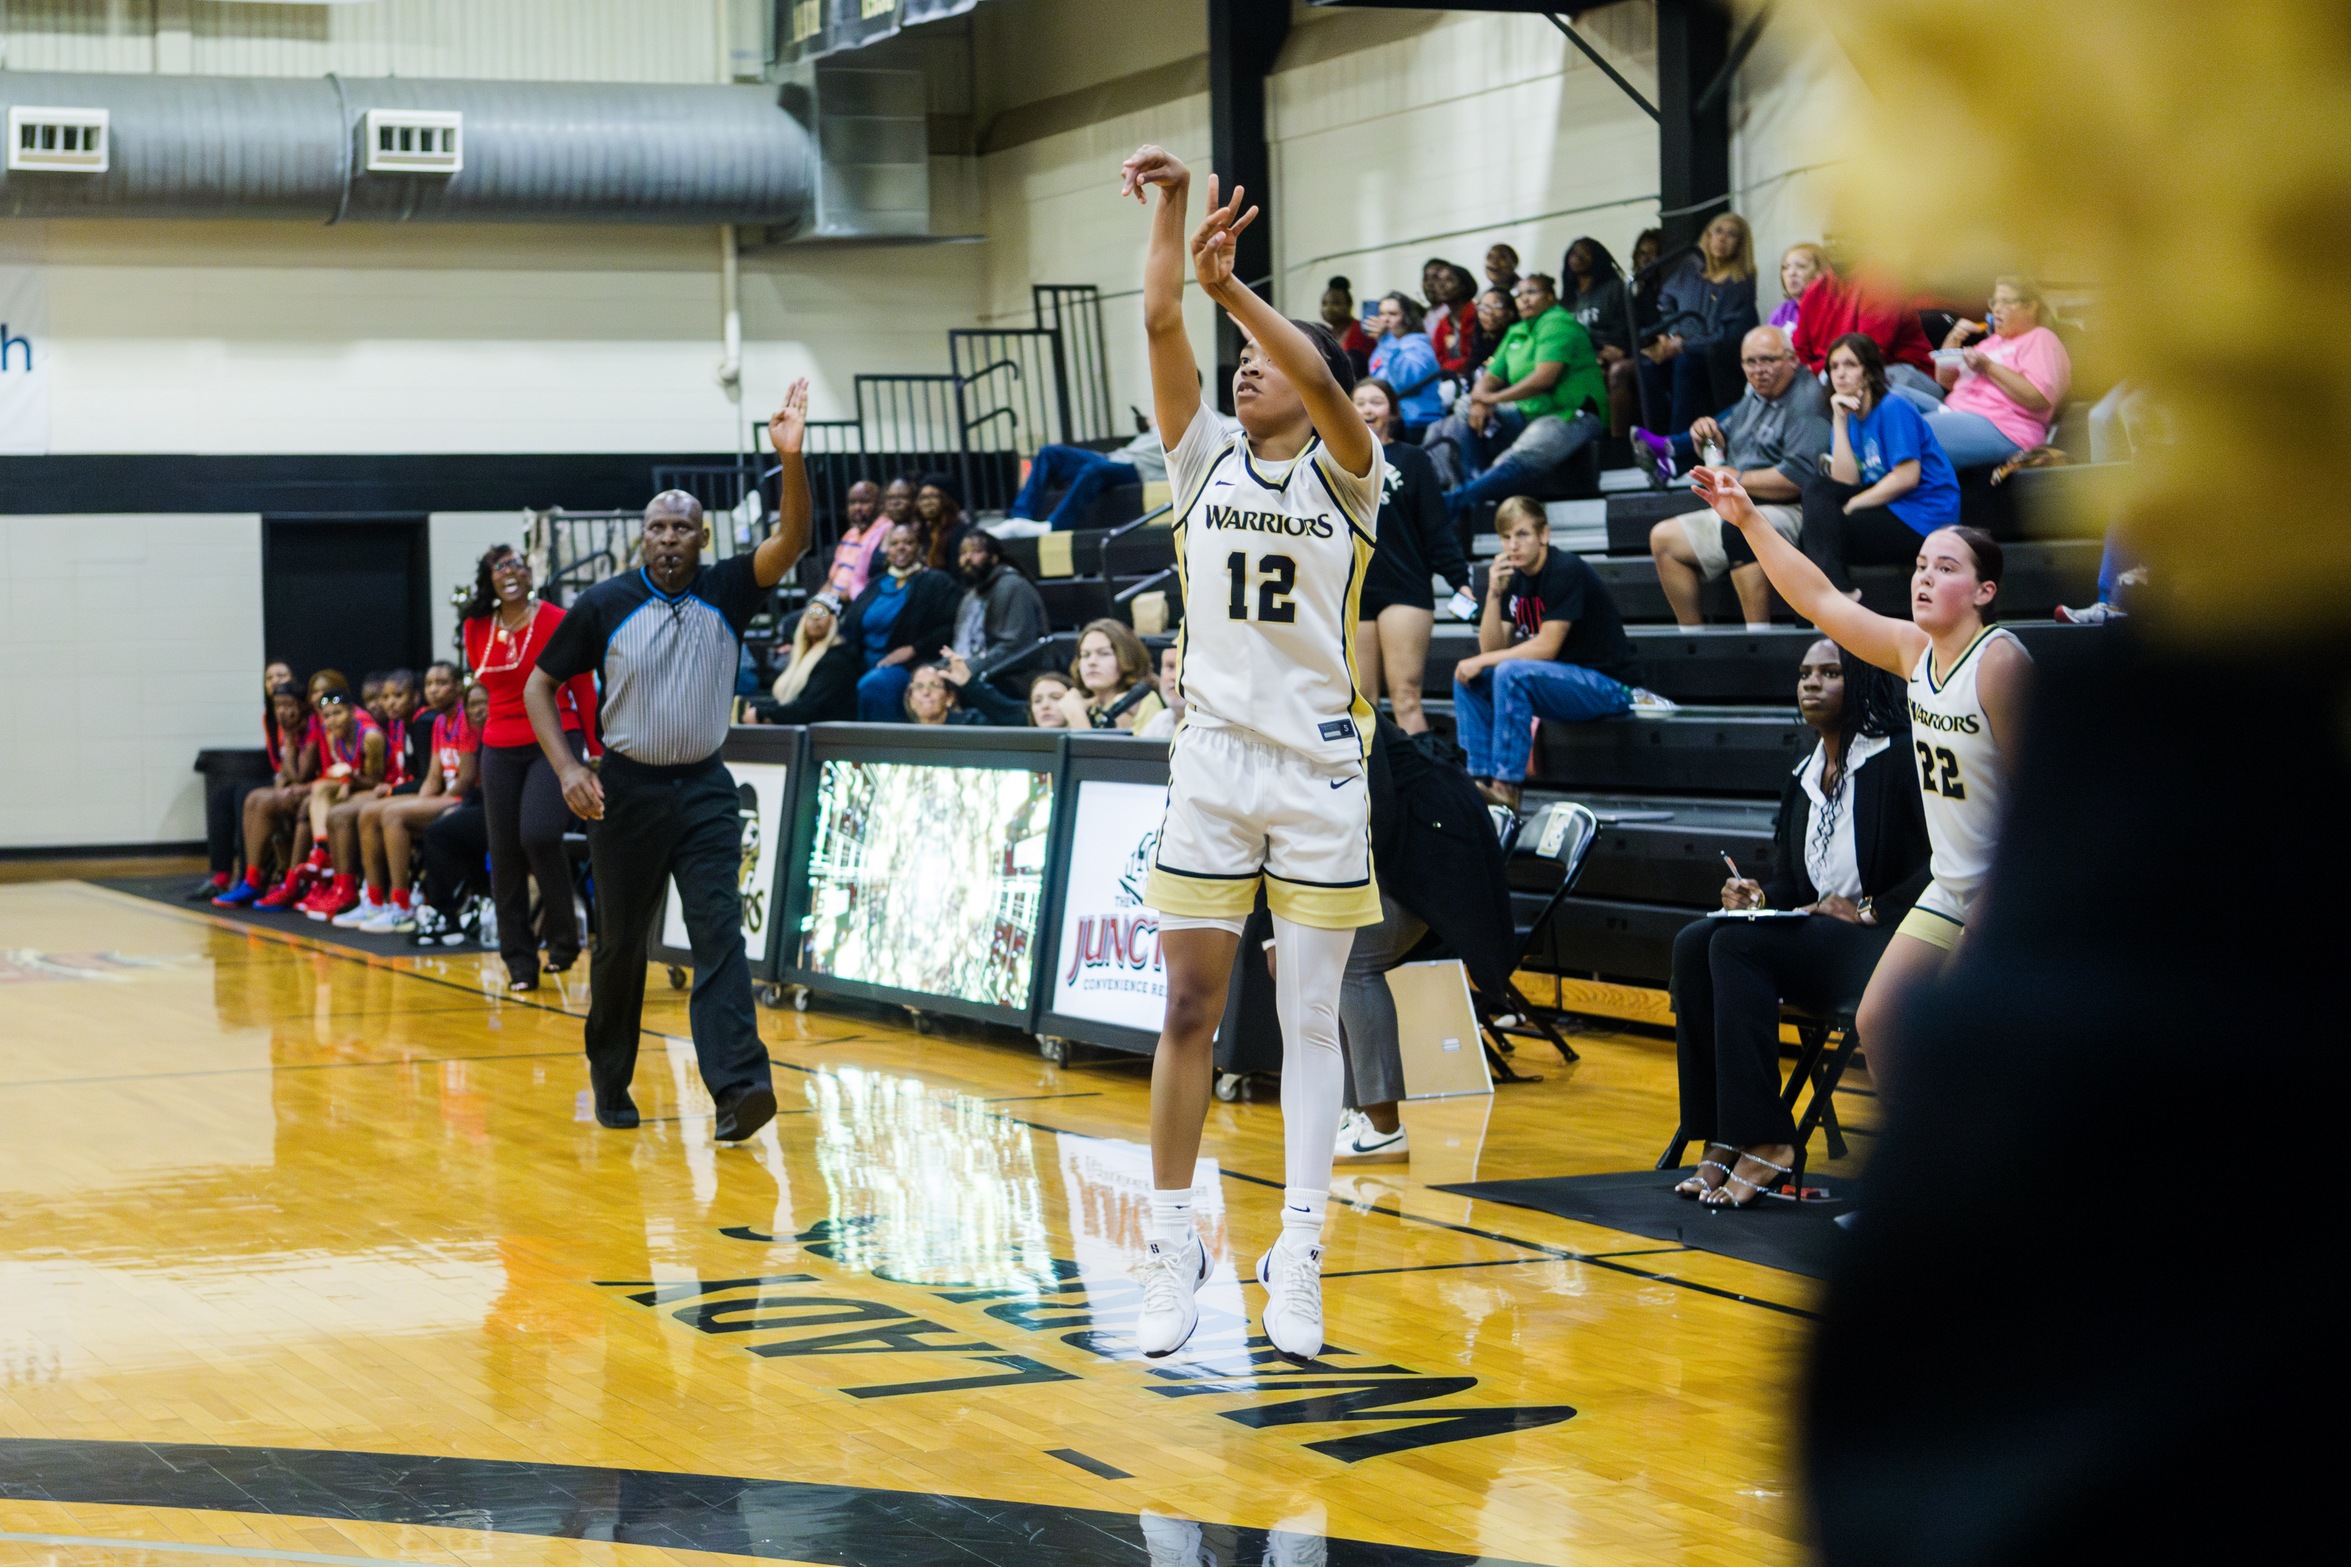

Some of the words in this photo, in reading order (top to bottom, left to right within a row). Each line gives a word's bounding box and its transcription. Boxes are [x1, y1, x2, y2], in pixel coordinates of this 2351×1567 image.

[1205, 503, 1334, 539] WARRIORS
[1227, 550, 1297, 624] 12
[1916, 740, 1966, 800] 22
[1083, 978, 1148, 994] CONVENIENCE
[1151, 983, 1167, 998] RE
[591, 1272, 1085, 1399] LADY
